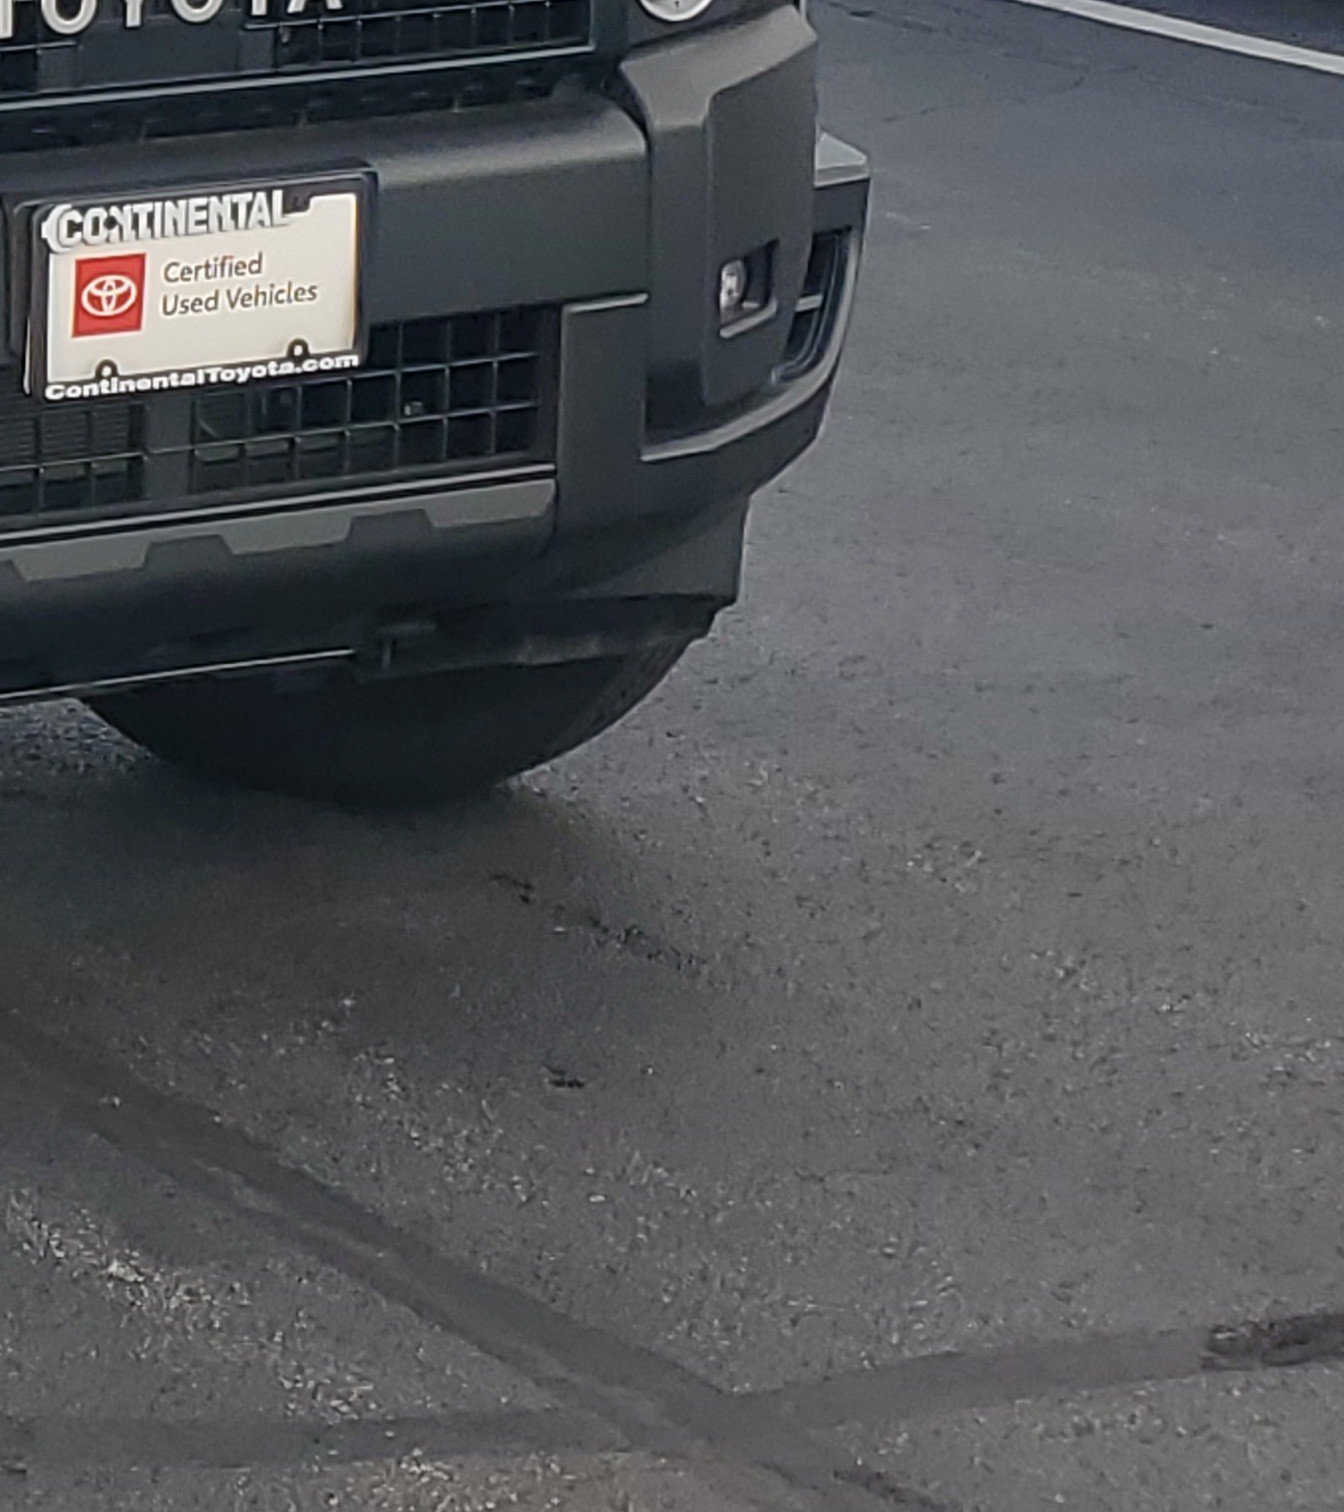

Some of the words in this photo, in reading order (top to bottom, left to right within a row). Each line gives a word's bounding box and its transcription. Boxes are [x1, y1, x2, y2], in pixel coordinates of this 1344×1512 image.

[57, 189, 291, 246] CONTINENTAL
[164, 252, 263, 283] Certified
[162, 289, 219, 316] Used
[226, 282, 317, 310] Vehicles
[45, 353, 360, 400] ContinentalToyota.com
